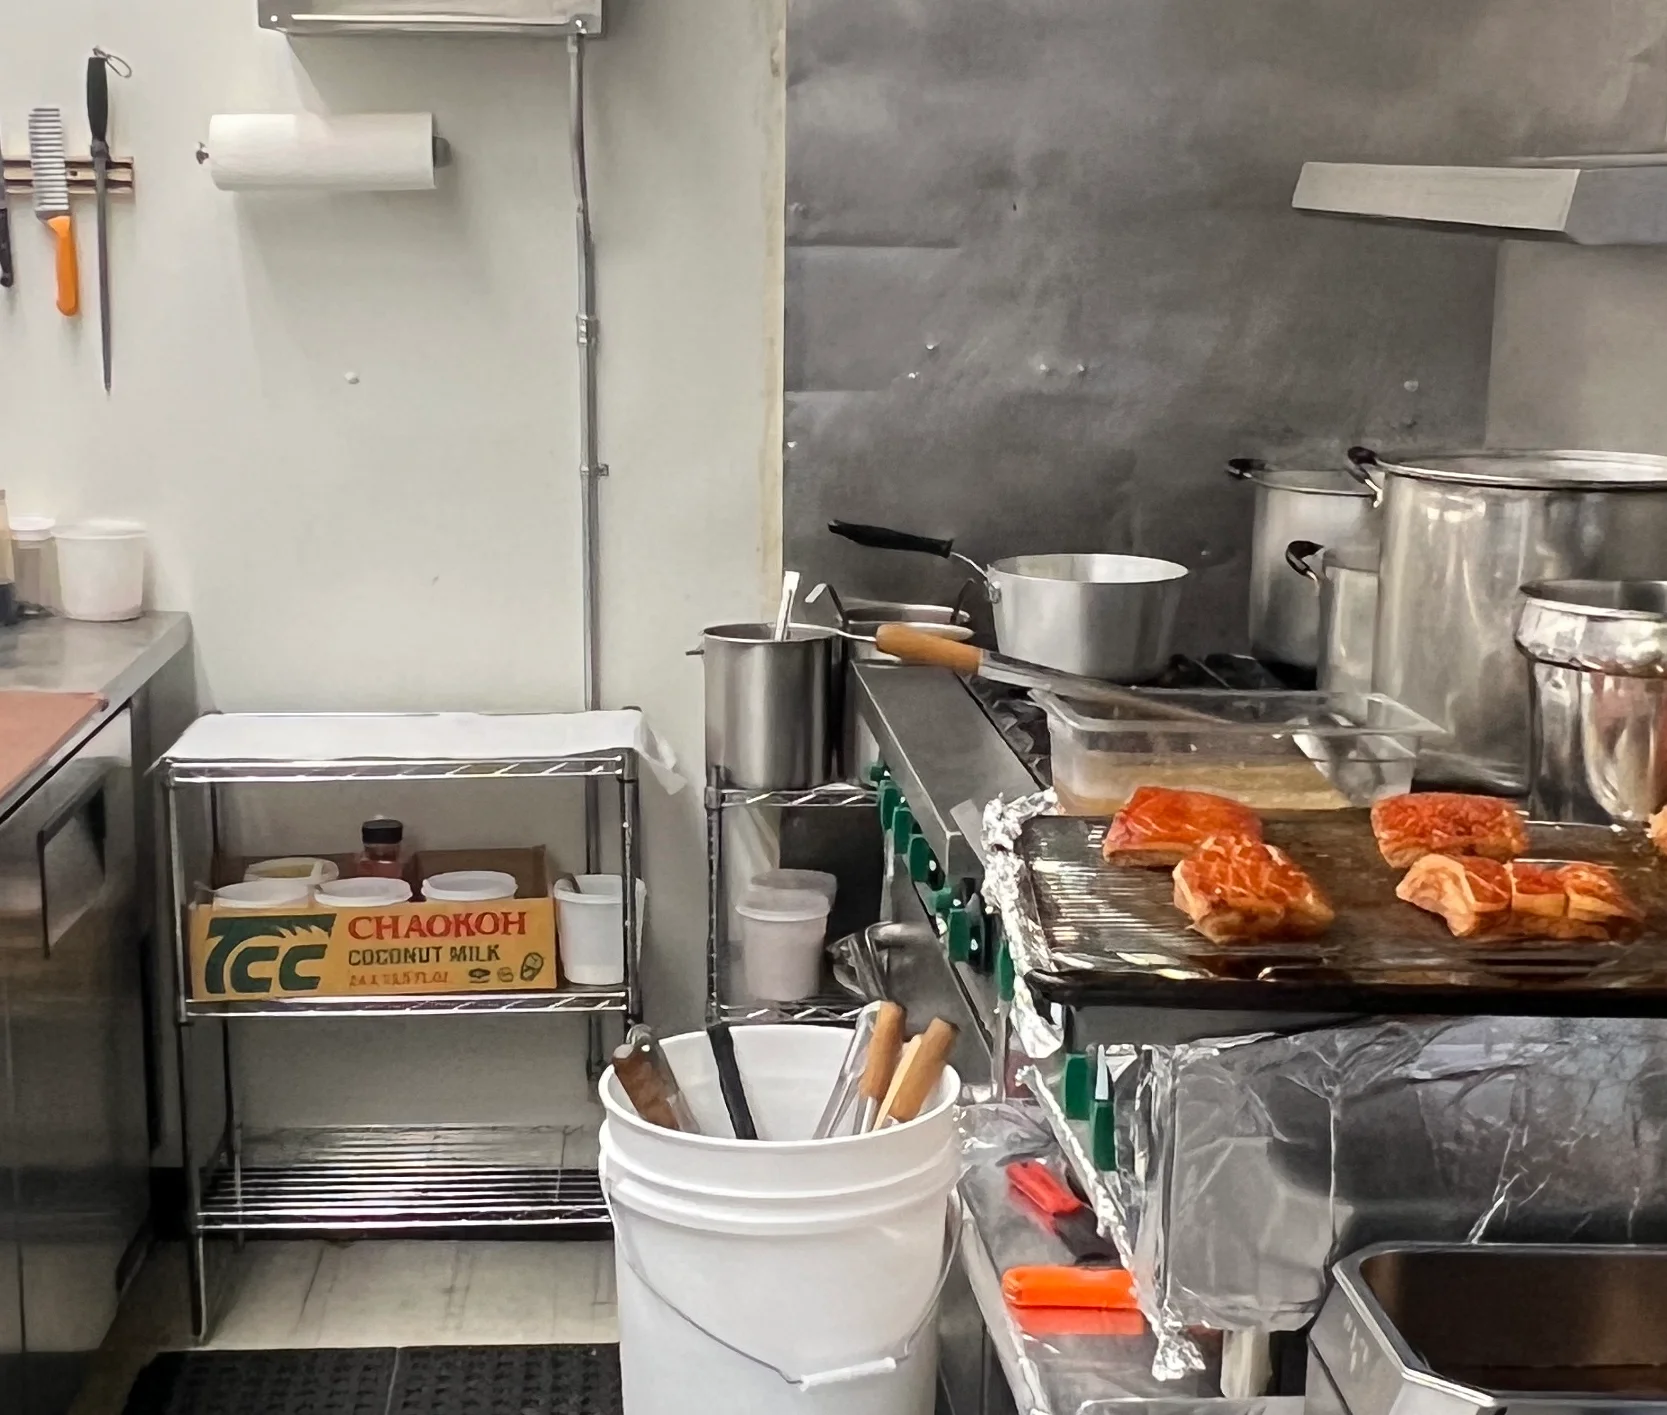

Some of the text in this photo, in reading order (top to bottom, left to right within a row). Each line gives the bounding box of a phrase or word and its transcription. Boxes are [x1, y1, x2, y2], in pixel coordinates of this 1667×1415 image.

[348, 911, 527, 940] CHAOKOH
[348, 944, 501, 966] COCONUT MILK
